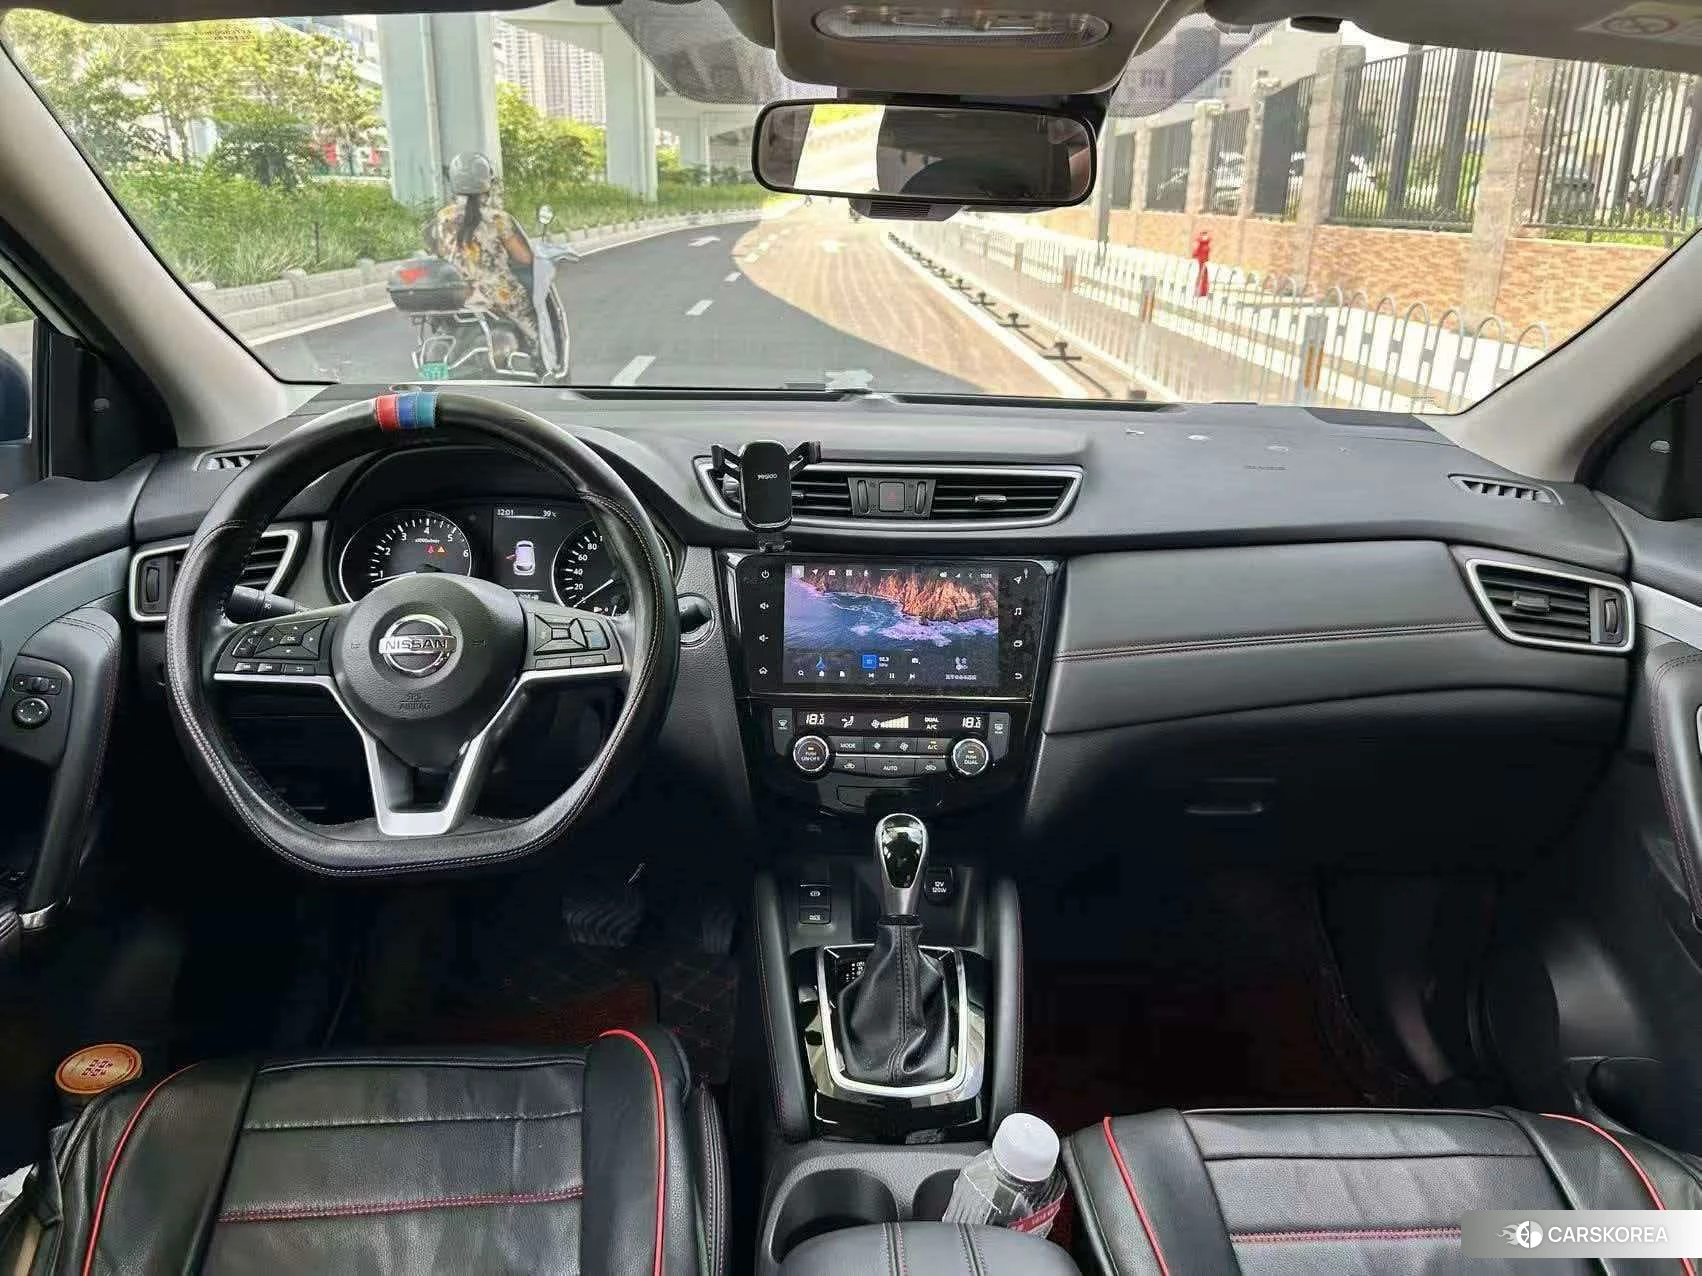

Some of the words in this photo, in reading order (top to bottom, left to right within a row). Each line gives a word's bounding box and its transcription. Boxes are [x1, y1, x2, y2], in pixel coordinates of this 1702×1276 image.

[423, 526, 430, 535] 4
[402, 532, 407, 541] 3
[447, 533, 453, 542] 5
[587, 542, 598, 550] 80
[384, 547, 391, 556] 2
[462, 549, 469, 558] 6
[573, 568, 584, 576] 40
[573, 583, 584, 591] 20
[385, 639, 449, 652] NISSAN
